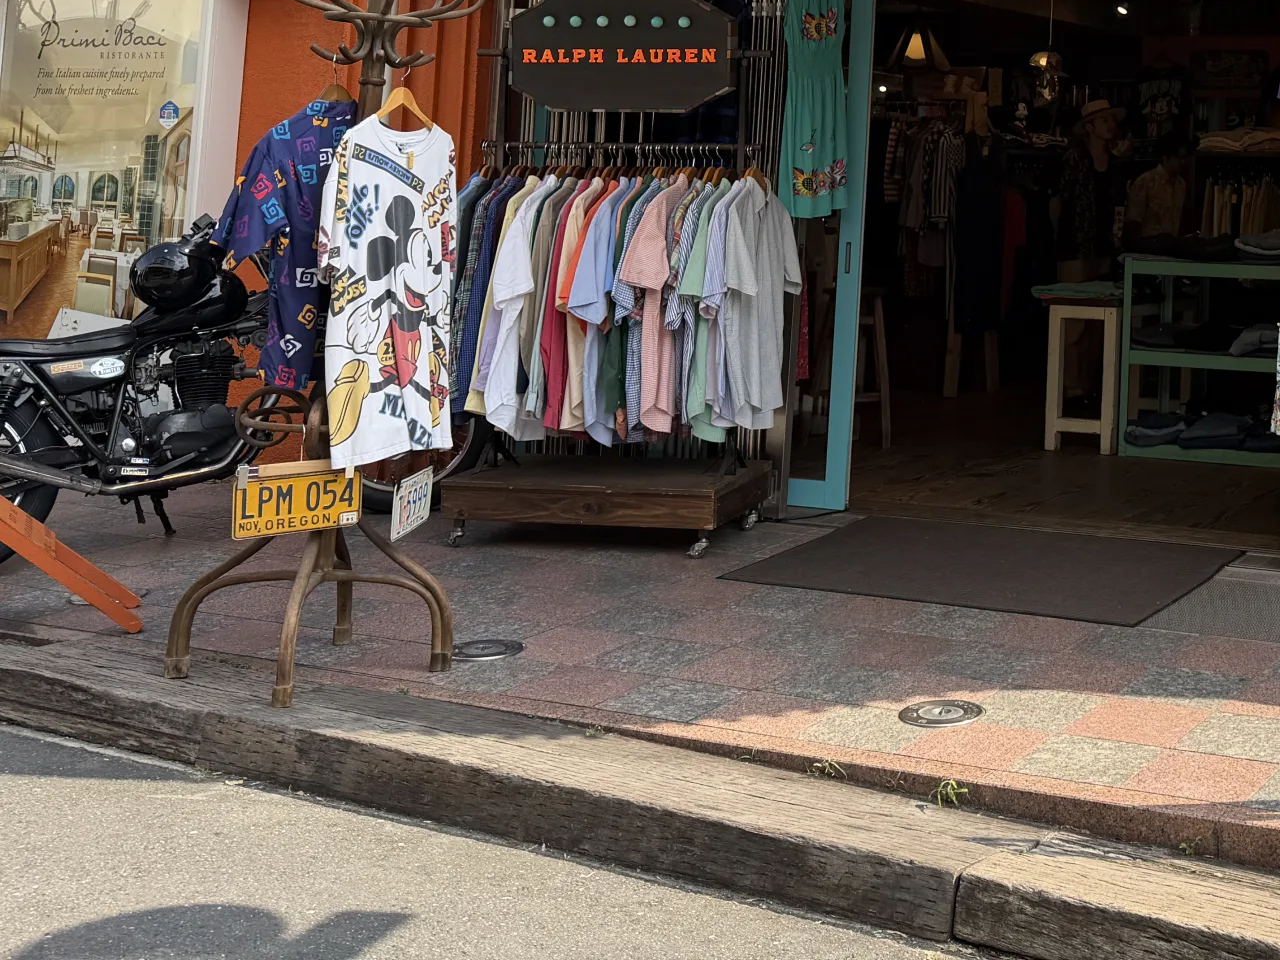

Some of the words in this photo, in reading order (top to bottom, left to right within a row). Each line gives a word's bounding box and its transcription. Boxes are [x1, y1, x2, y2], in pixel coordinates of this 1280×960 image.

[37, 18, 110, 60] Primi
[115, 17, 167, 47] Baci
[100, 51, 165, 59] RISTORANTE
[522, 48, 605, 64] RALPH
[616, 48, 717, 64] LAUREN
[37, 68, 53, 79] Fine
[55, 67, 81, 79] Italian
[82, 69, 108, 79] cuisine
[107, 67, 130, 82] finely
[130, 67, 166, 82] prepared
[34, 84, 53, 98] from
[54, 84, 65, 96] the
[66, 84, 94, 98] freshest
[95, 85, 139, 99] ingredients.
[240, 483, 293, 520] LPM
[306, 478, 354, 512] 054
[265, 513, 332, 530] OREGON
